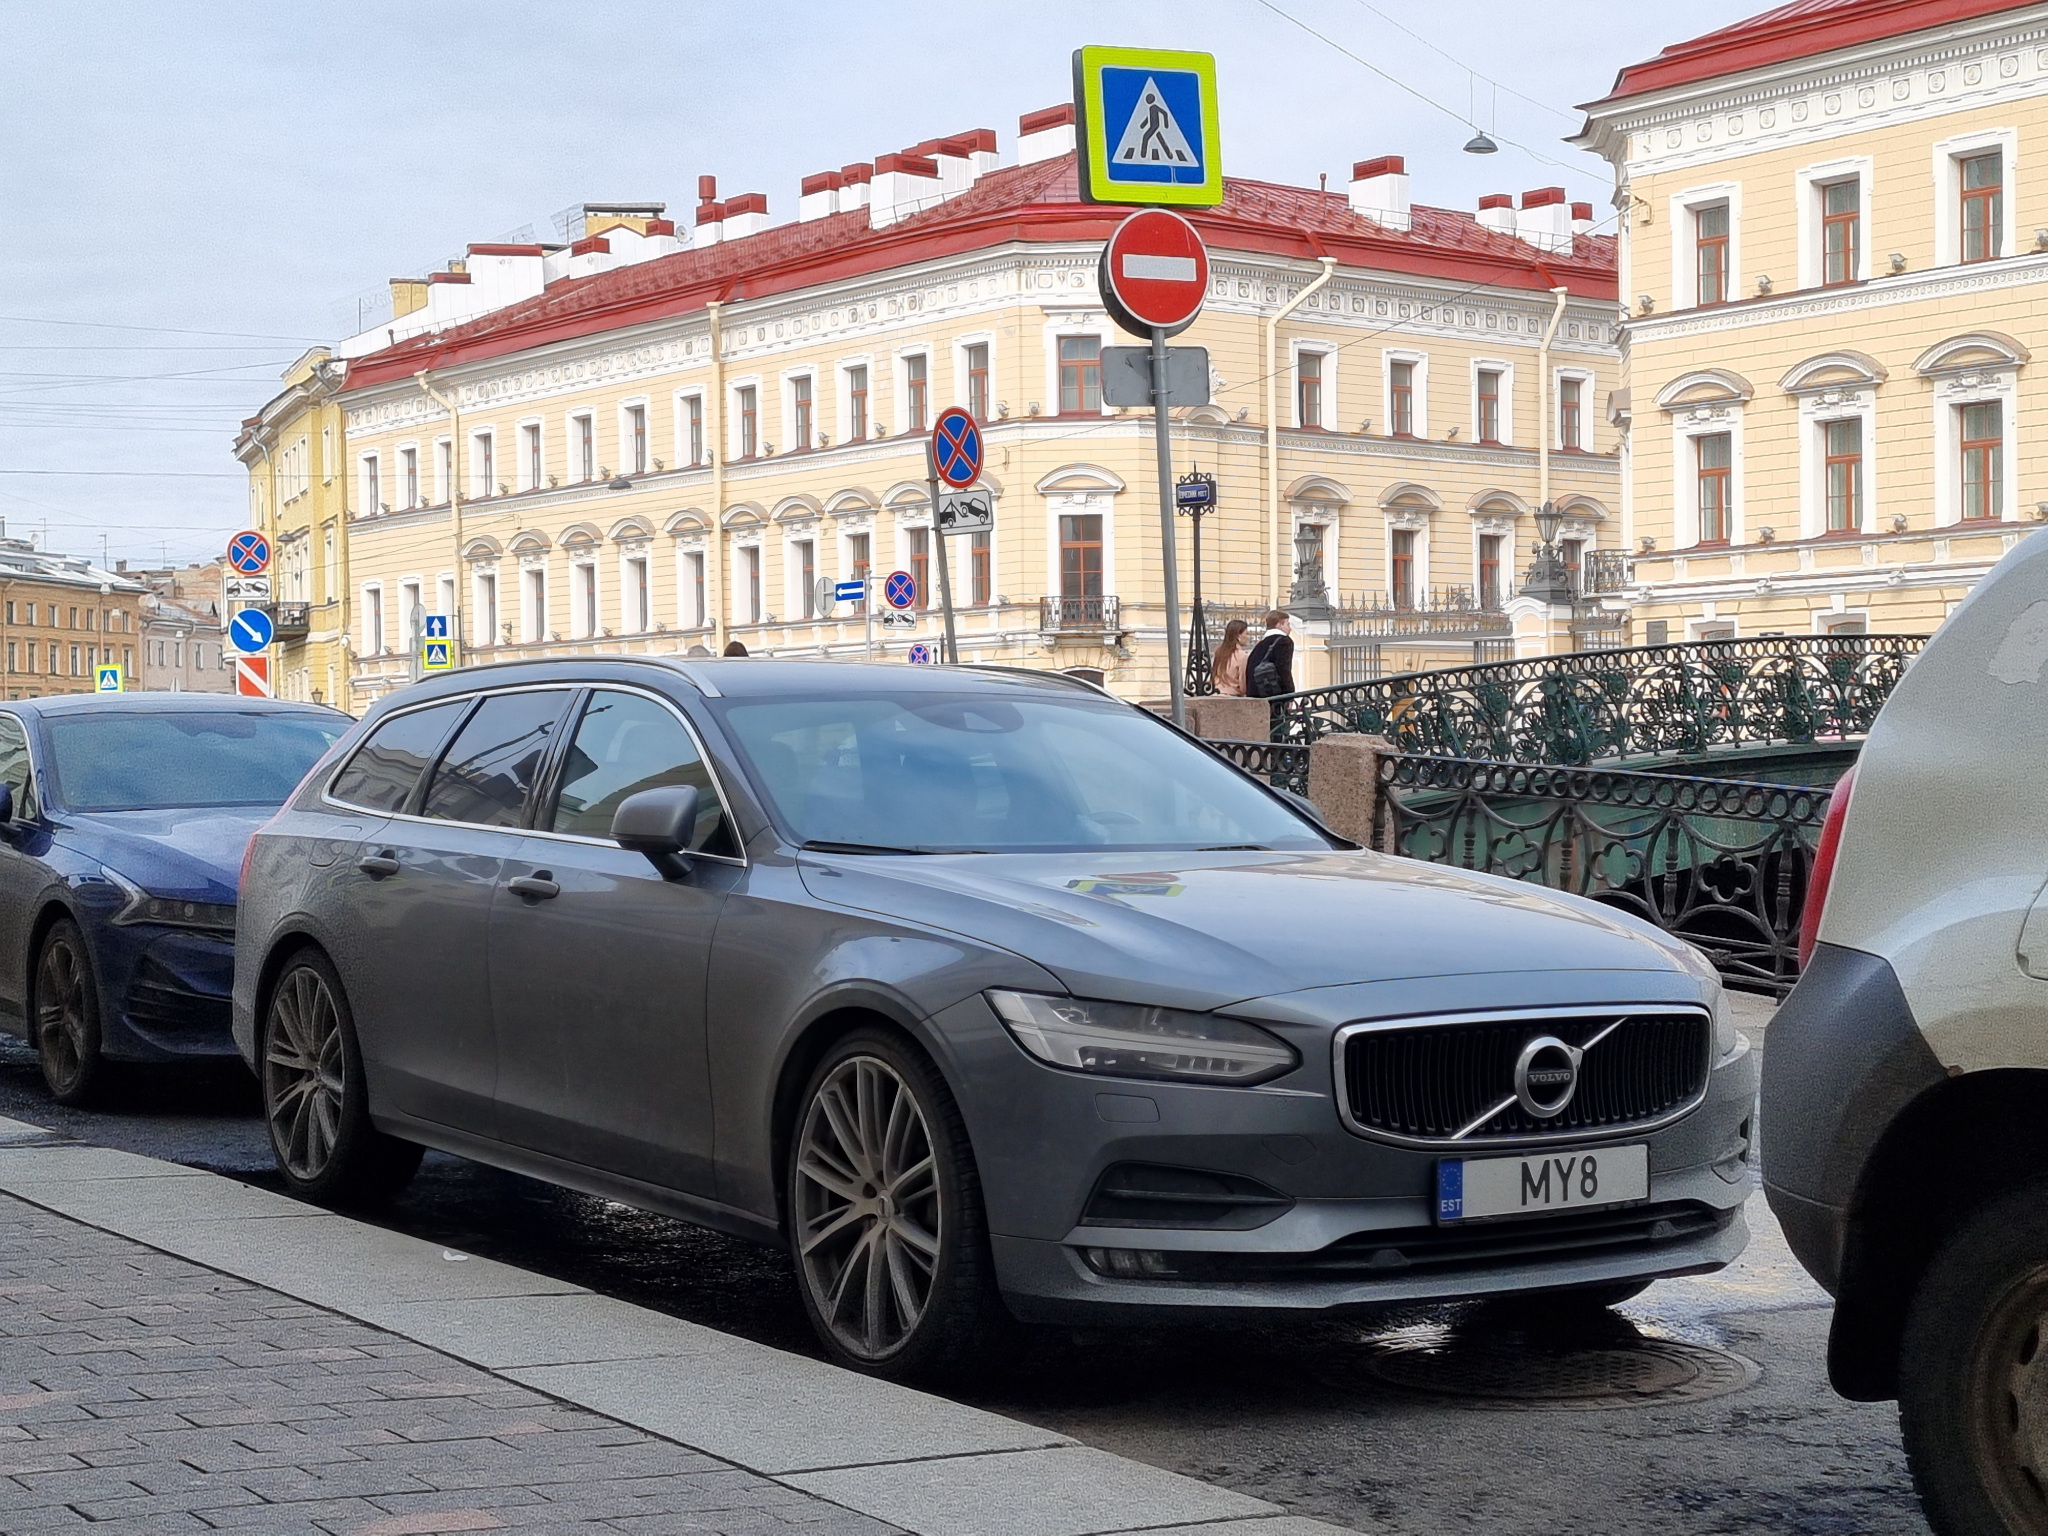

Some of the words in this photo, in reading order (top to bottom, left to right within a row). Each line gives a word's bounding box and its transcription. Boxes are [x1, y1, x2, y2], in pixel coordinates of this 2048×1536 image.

[1529, 1072, 1571, 1082] VOLVO
[1521, 1155, 1598, 1206] MY8
[1441, 1199, 1462, 1212] EST
